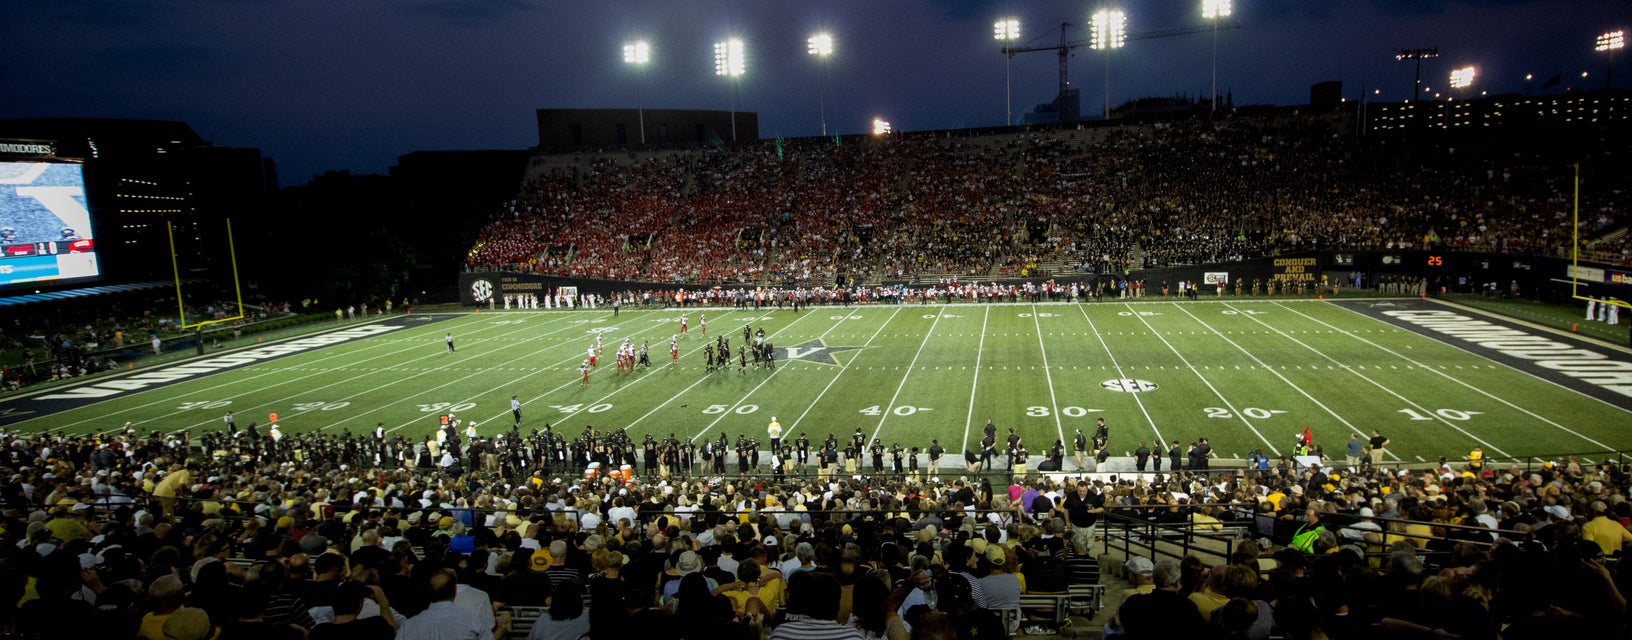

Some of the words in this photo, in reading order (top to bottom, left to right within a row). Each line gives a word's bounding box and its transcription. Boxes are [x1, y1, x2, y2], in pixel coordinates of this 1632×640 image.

[1273, 258, 1316, 267] CONQUER
[1428, 256, 1442, 266] 25
[1285, 266, 1305, 274] AND
[472, 280, 492, 300] SEC
[1100, 379, 1158, 392] SEC
[702, 404, 759, 415] 50
[858, 405, 917, 416] 40
[1026, 406, 1087, 417] 30
[1203, 407, 1272, 419] 20
[1398, 408, 1471, 421] 10
